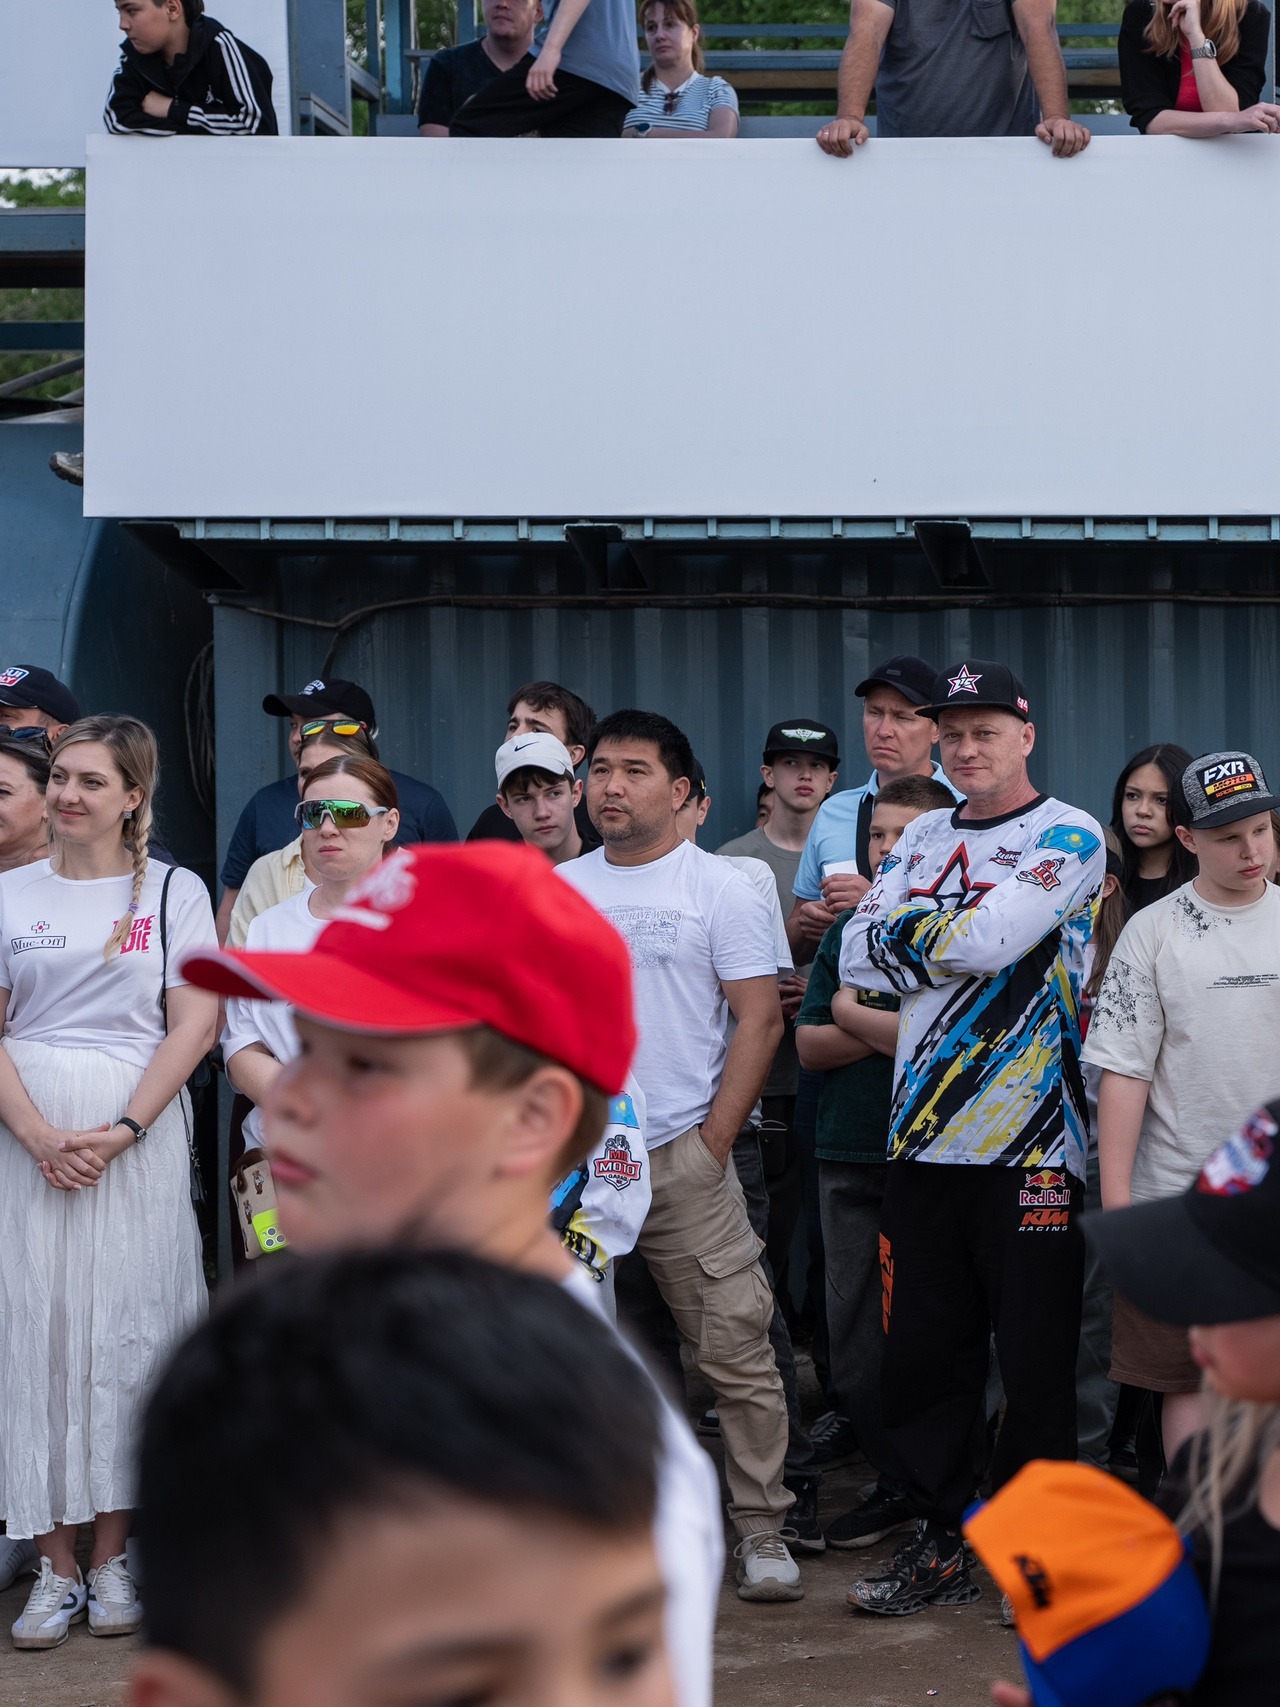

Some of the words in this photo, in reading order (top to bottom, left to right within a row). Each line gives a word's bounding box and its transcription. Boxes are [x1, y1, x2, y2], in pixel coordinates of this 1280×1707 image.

[1204, 761, 1245, 785] FXR
[628, 911, 652, 921] HAVE
[653, 909, 682, 922] WINGS
[13, 937, 64, 951] Muc-Off
[600, 1161, 636, 1176] MOTO
[1019, 1190, 1046, 1205] Red
[1047, 1190, 1070, 1205] Bull
[1021, 1208, 1069, 1226] KTM
